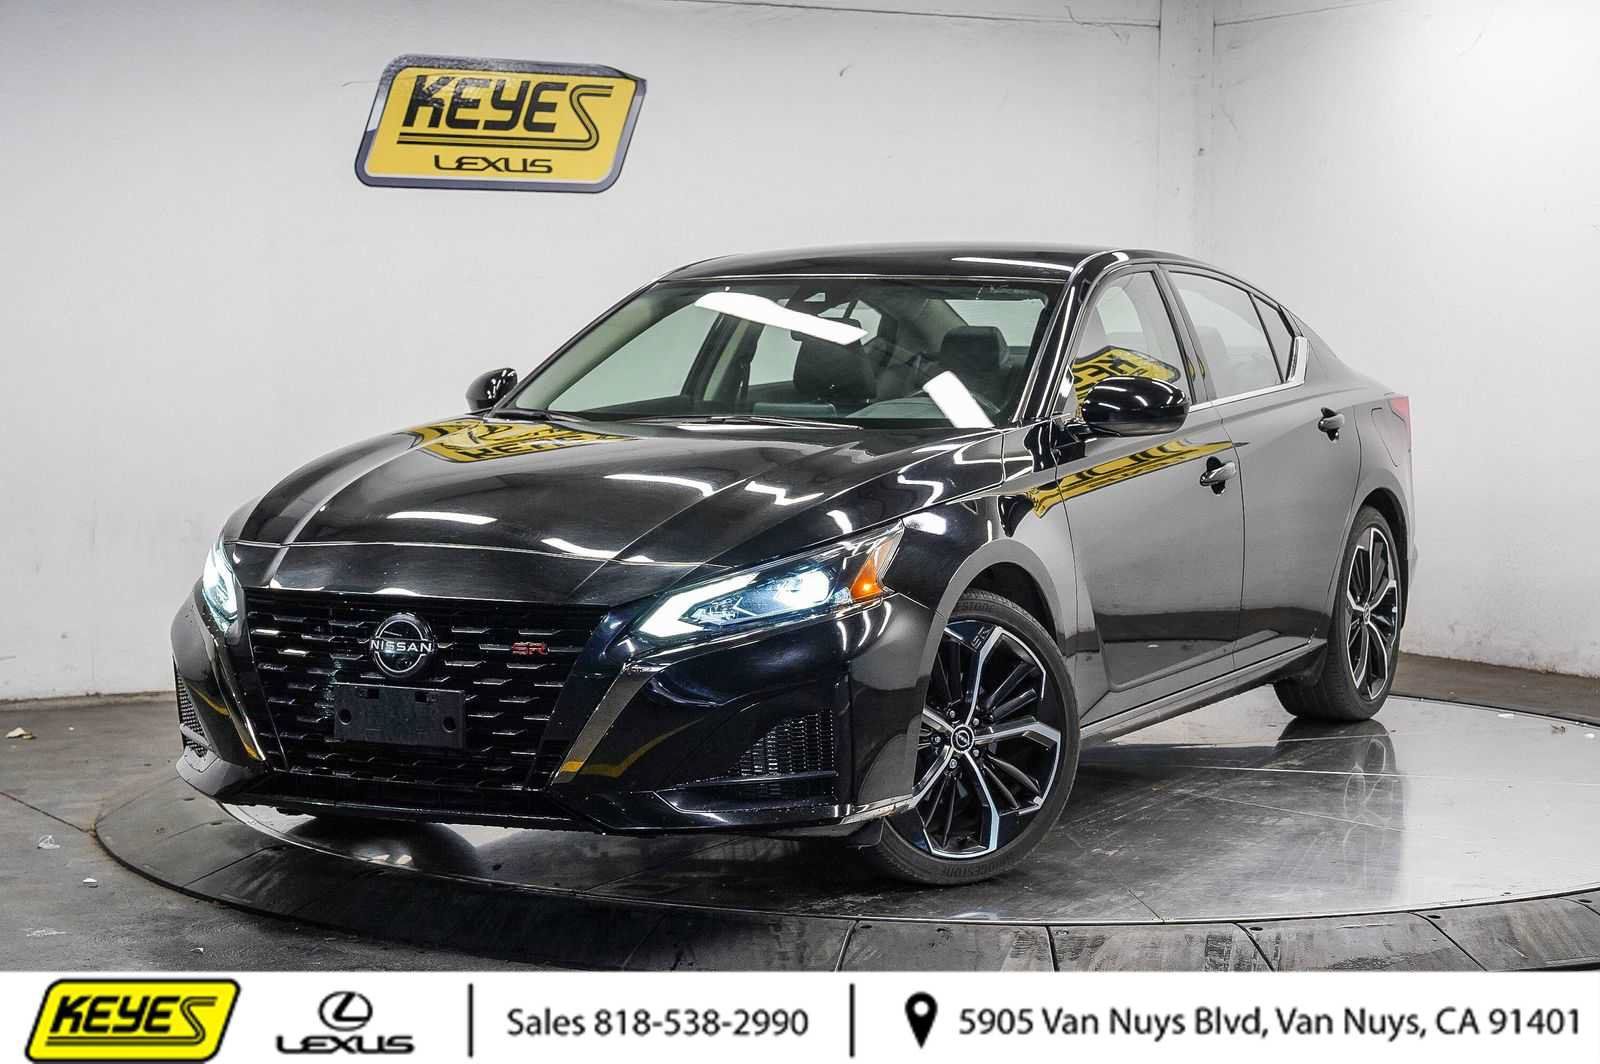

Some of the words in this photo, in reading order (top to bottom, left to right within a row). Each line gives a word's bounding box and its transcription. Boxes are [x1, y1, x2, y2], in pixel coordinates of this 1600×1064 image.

[400, 75, 615, 149] KEYES
[433, 154, 553, 174] LEXUS
[369, 638, 433, 654] NISSAN
[511, 641, 547, 656] SR
